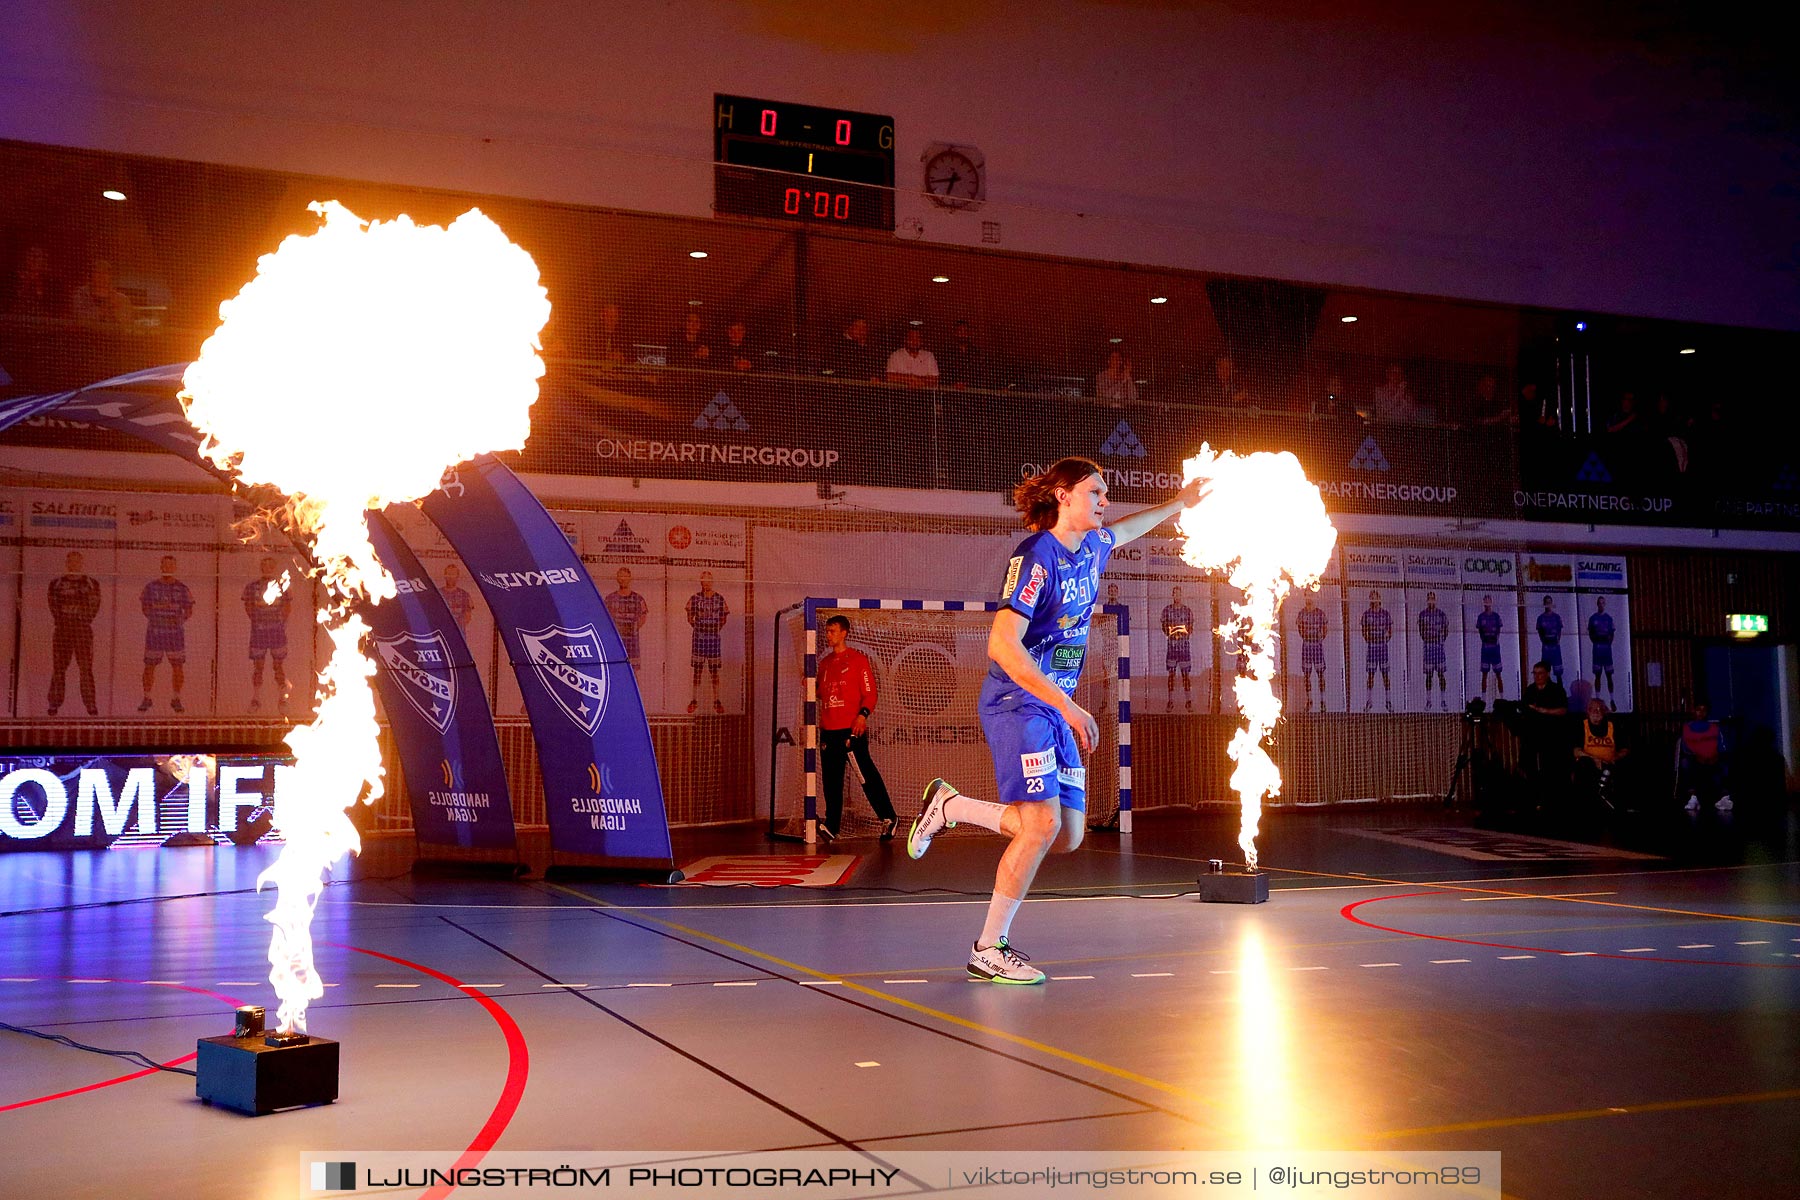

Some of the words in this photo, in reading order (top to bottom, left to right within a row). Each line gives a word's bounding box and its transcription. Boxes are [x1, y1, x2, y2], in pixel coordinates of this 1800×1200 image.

[718, 104, 734, 129] H
[760, 109, 777, 136] 0
[835, 119, 851, 146] 0
[878, 125, 893, 149] G
[596, 438, 839, 468] ONEPARTNERGROUP
[1061, 577, 1079, 604] 23
[1026, 777, 1045, 794] 23
